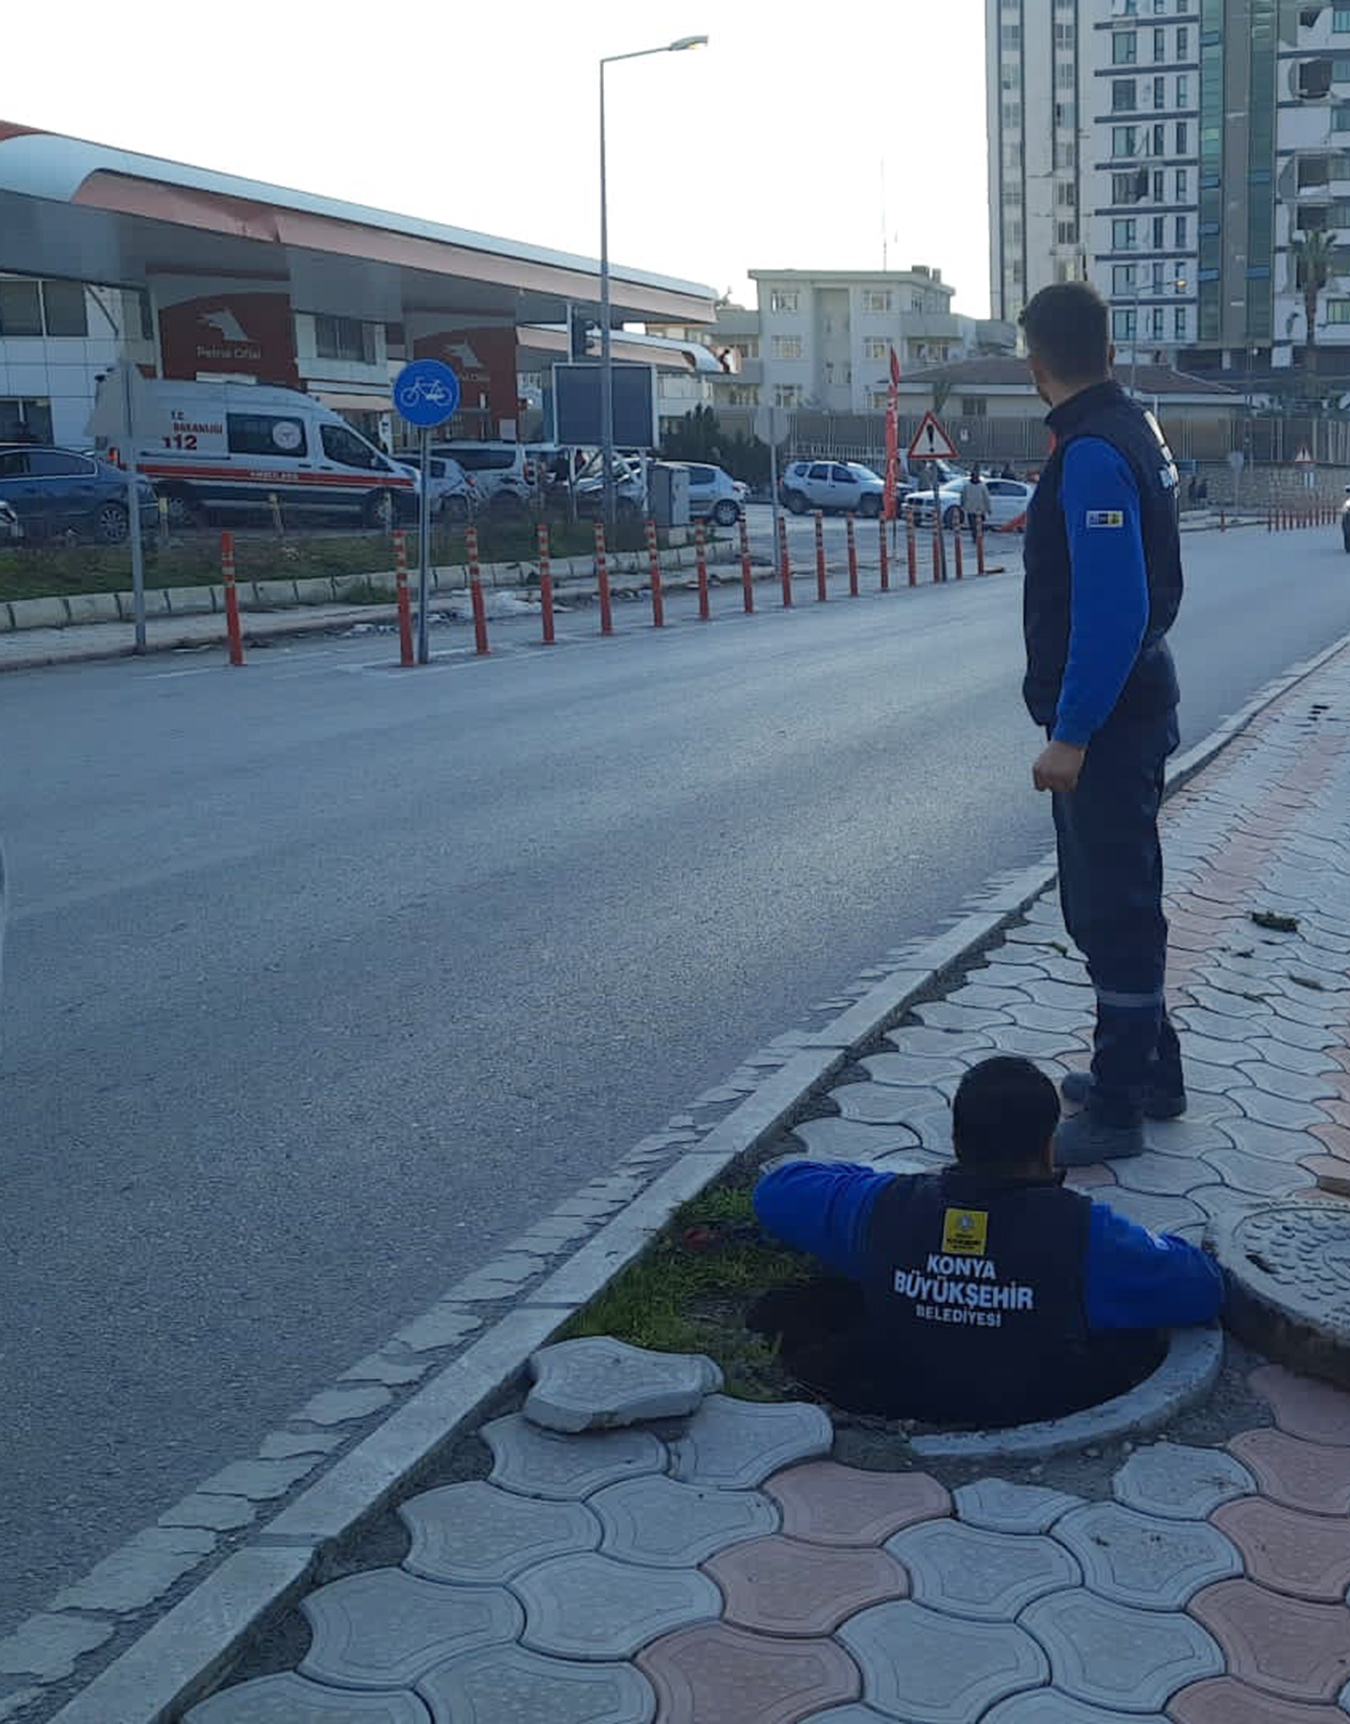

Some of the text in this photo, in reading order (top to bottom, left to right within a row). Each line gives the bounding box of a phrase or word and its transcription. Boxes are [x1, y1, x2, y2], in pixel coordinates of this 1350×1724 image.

[161, 433, 198, 451] 112
[927, 1253, 996, 1280] KONYA
[894, 1269, 1034, 1310] BÜYÜKŞEHİR
[916, 1304, 1001, 1328] BELEDİYESİ
